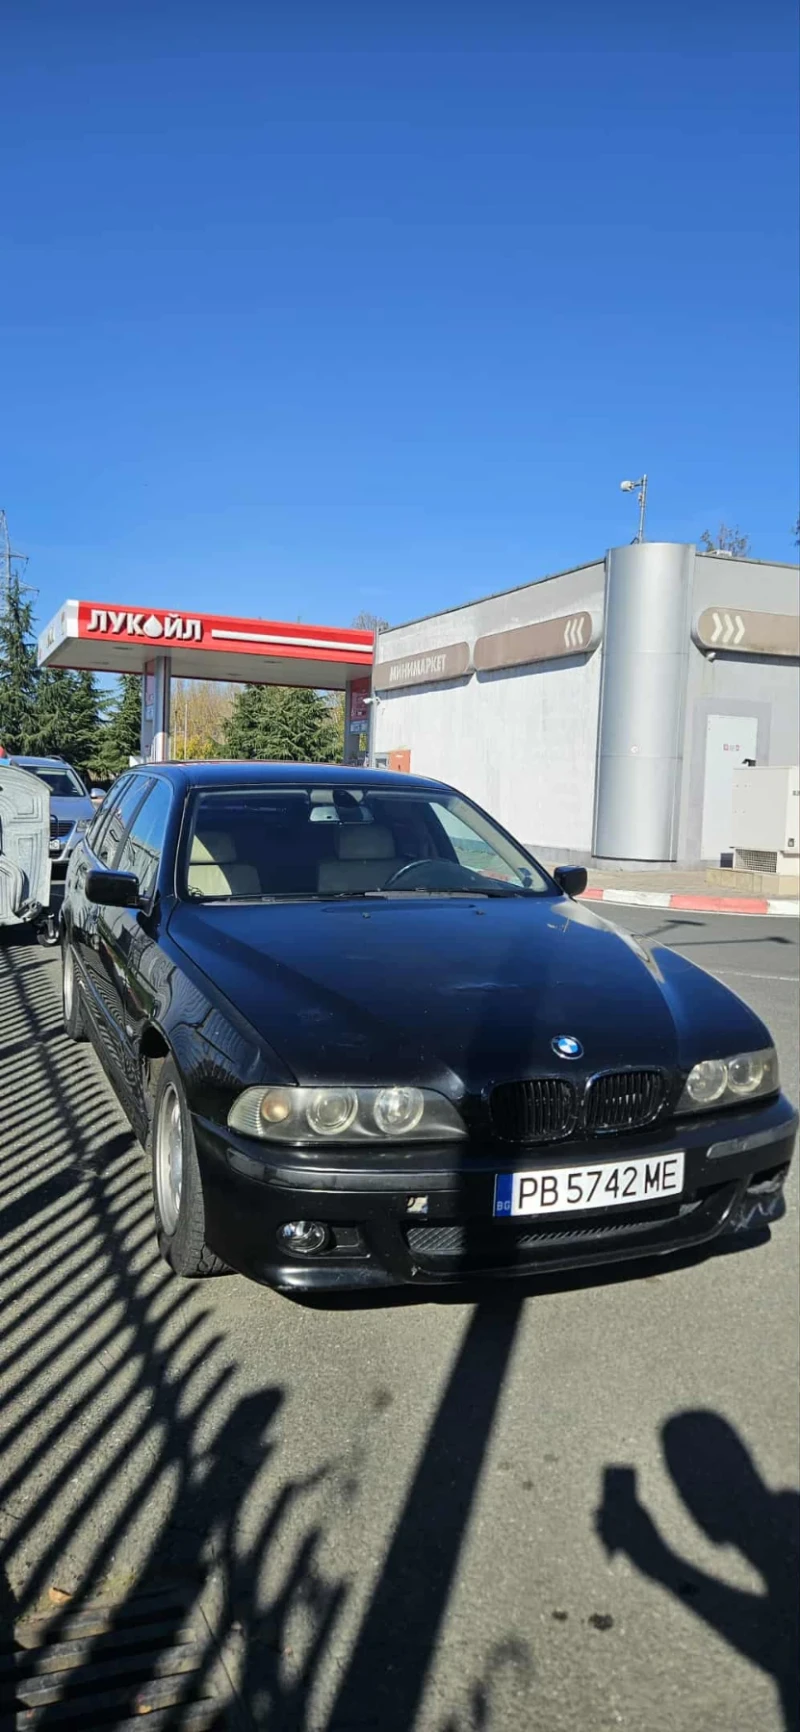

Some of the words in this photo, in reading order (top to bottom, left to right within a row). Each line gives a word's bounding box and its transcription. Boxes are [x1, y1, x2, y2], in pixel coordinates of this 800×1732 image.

[86, 609, 202, 641] ЛУКОЙЛ
[389, 654, 447, 681] МИНИМАРКЕТ
[518, 1176, 559, 1210] PB
[566, 1167, 638, 1205] 5742
[644, 1159, 678, 1195] ME
[496, 1200, 512, 1211] BG
